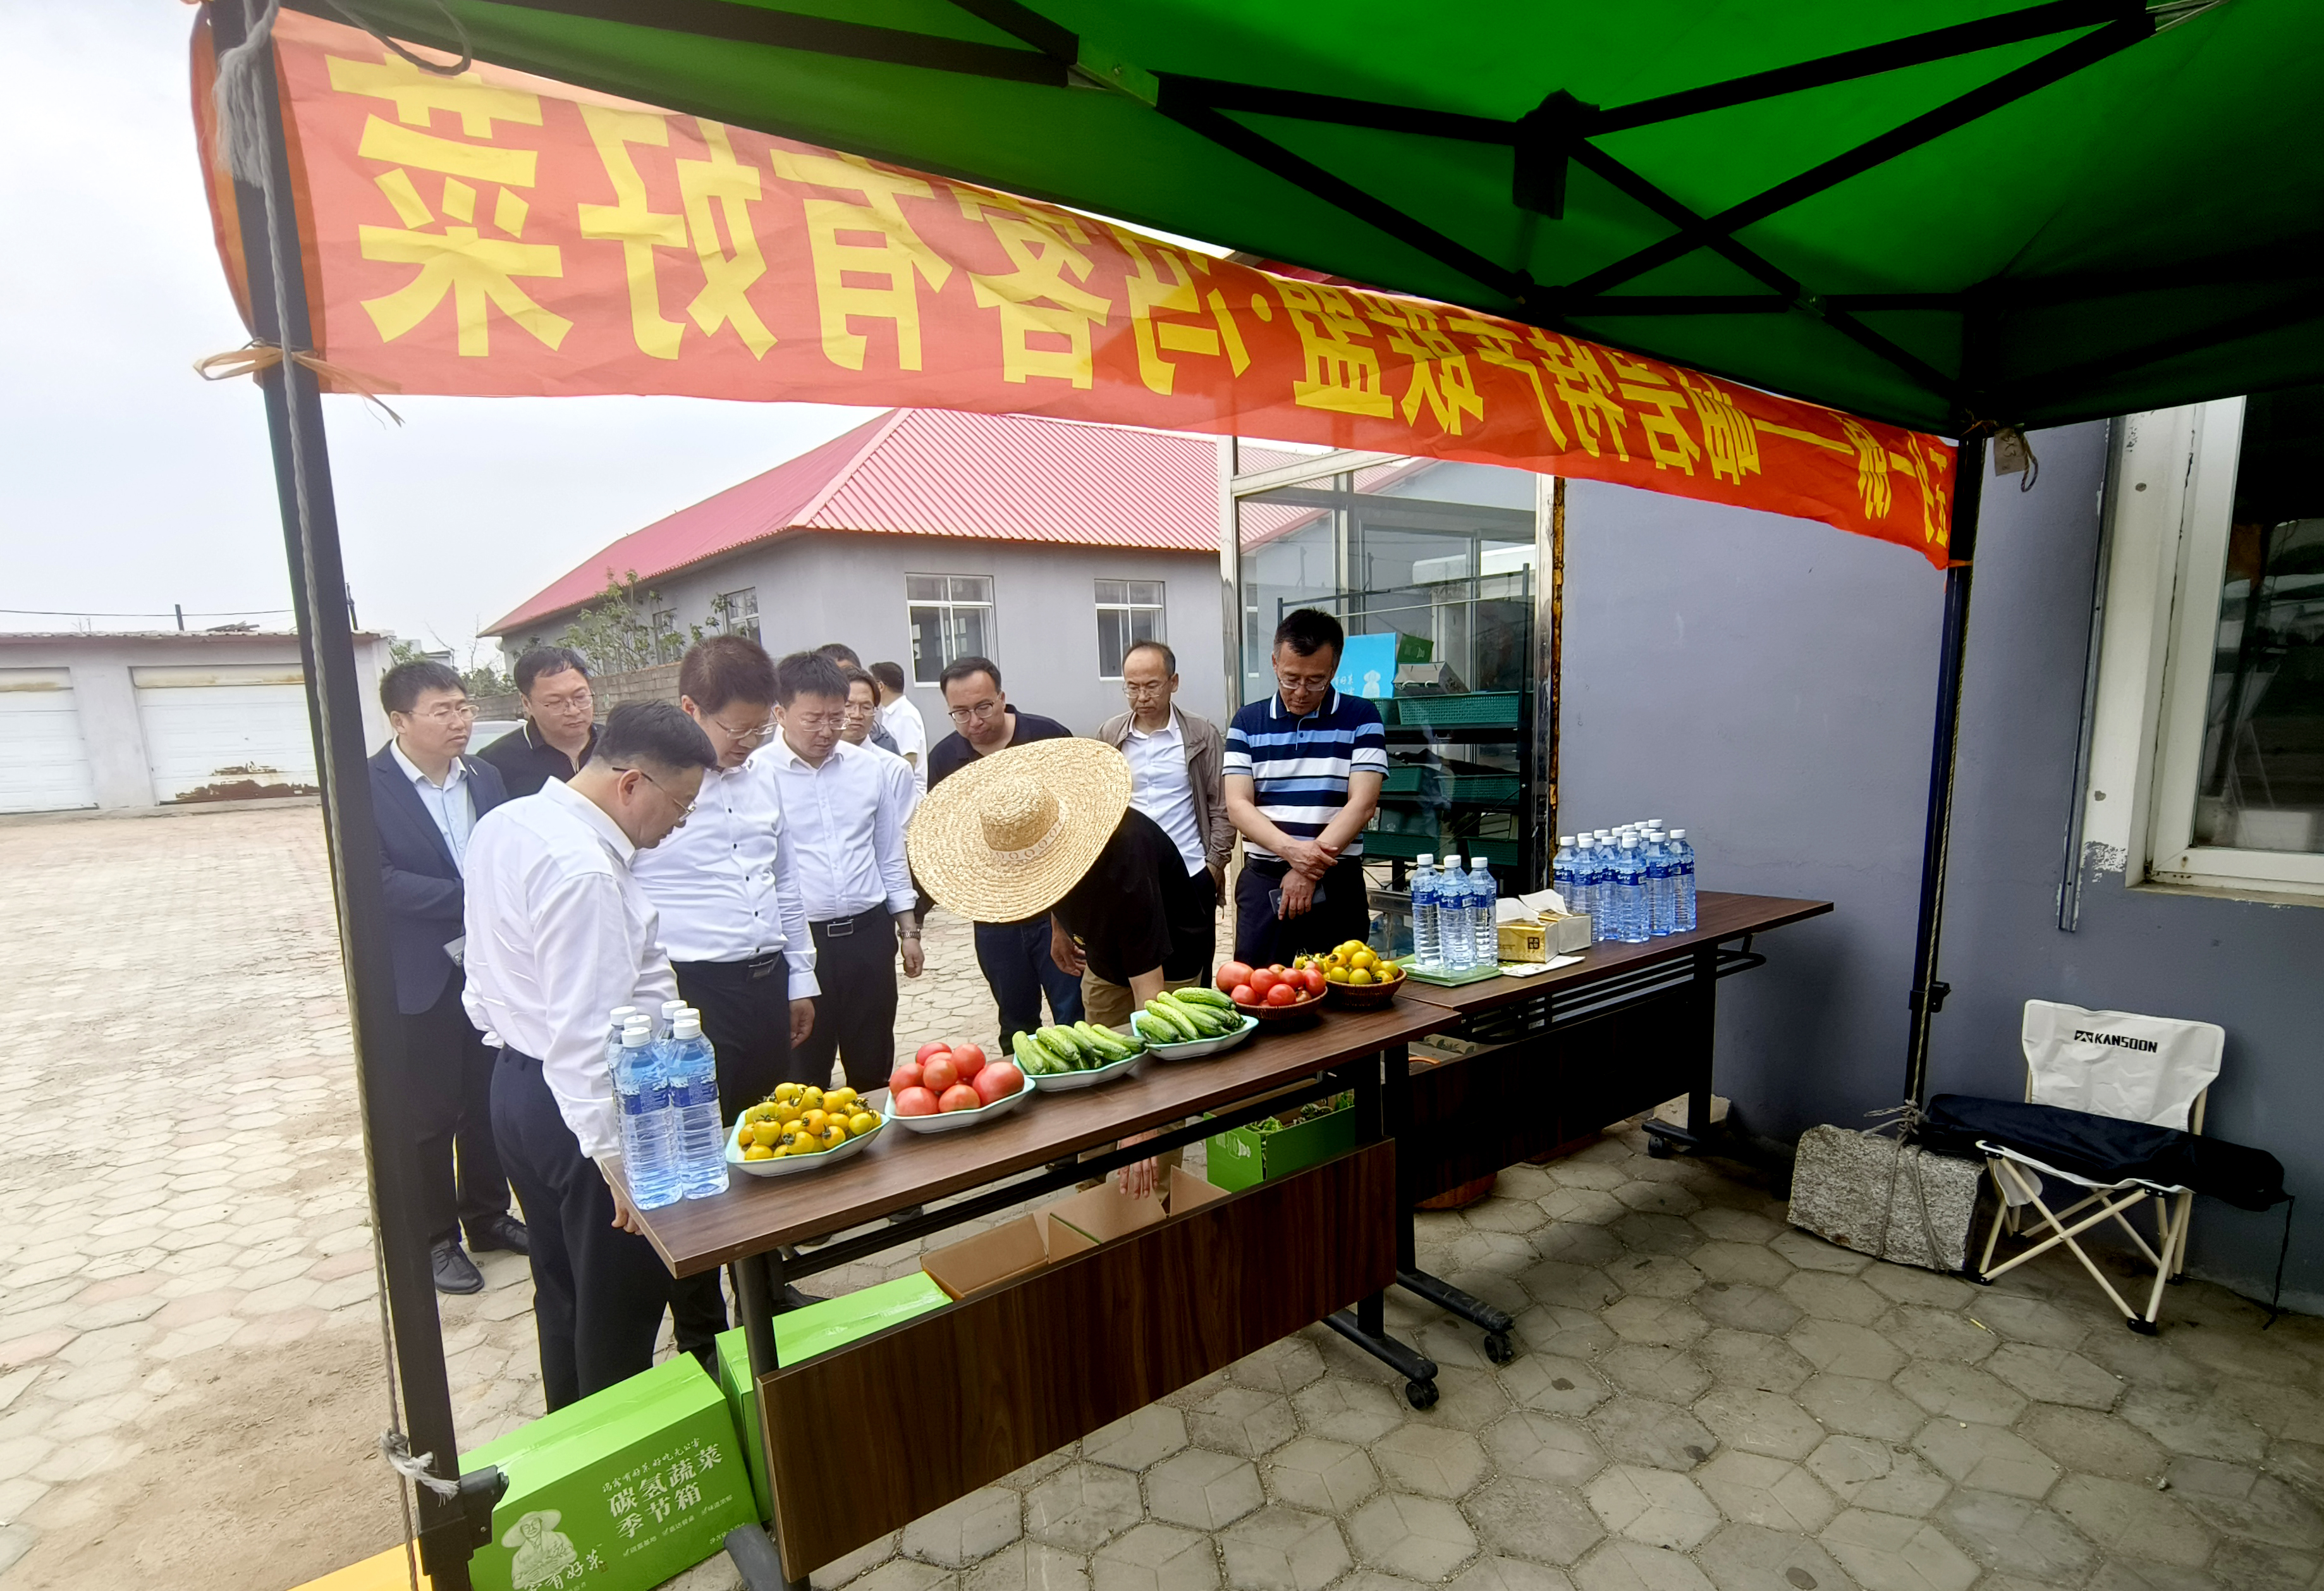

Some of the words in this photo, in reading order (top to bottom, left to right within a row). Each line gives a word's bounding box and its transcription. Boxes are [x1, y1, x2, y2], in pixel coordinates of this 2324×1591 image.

[2095, 1033, 2158, 1053] KANSOON
[607, 1442, 724, 1518] 碳氢蔬菜
[616, 1482, 702, 1539] 季节箱
